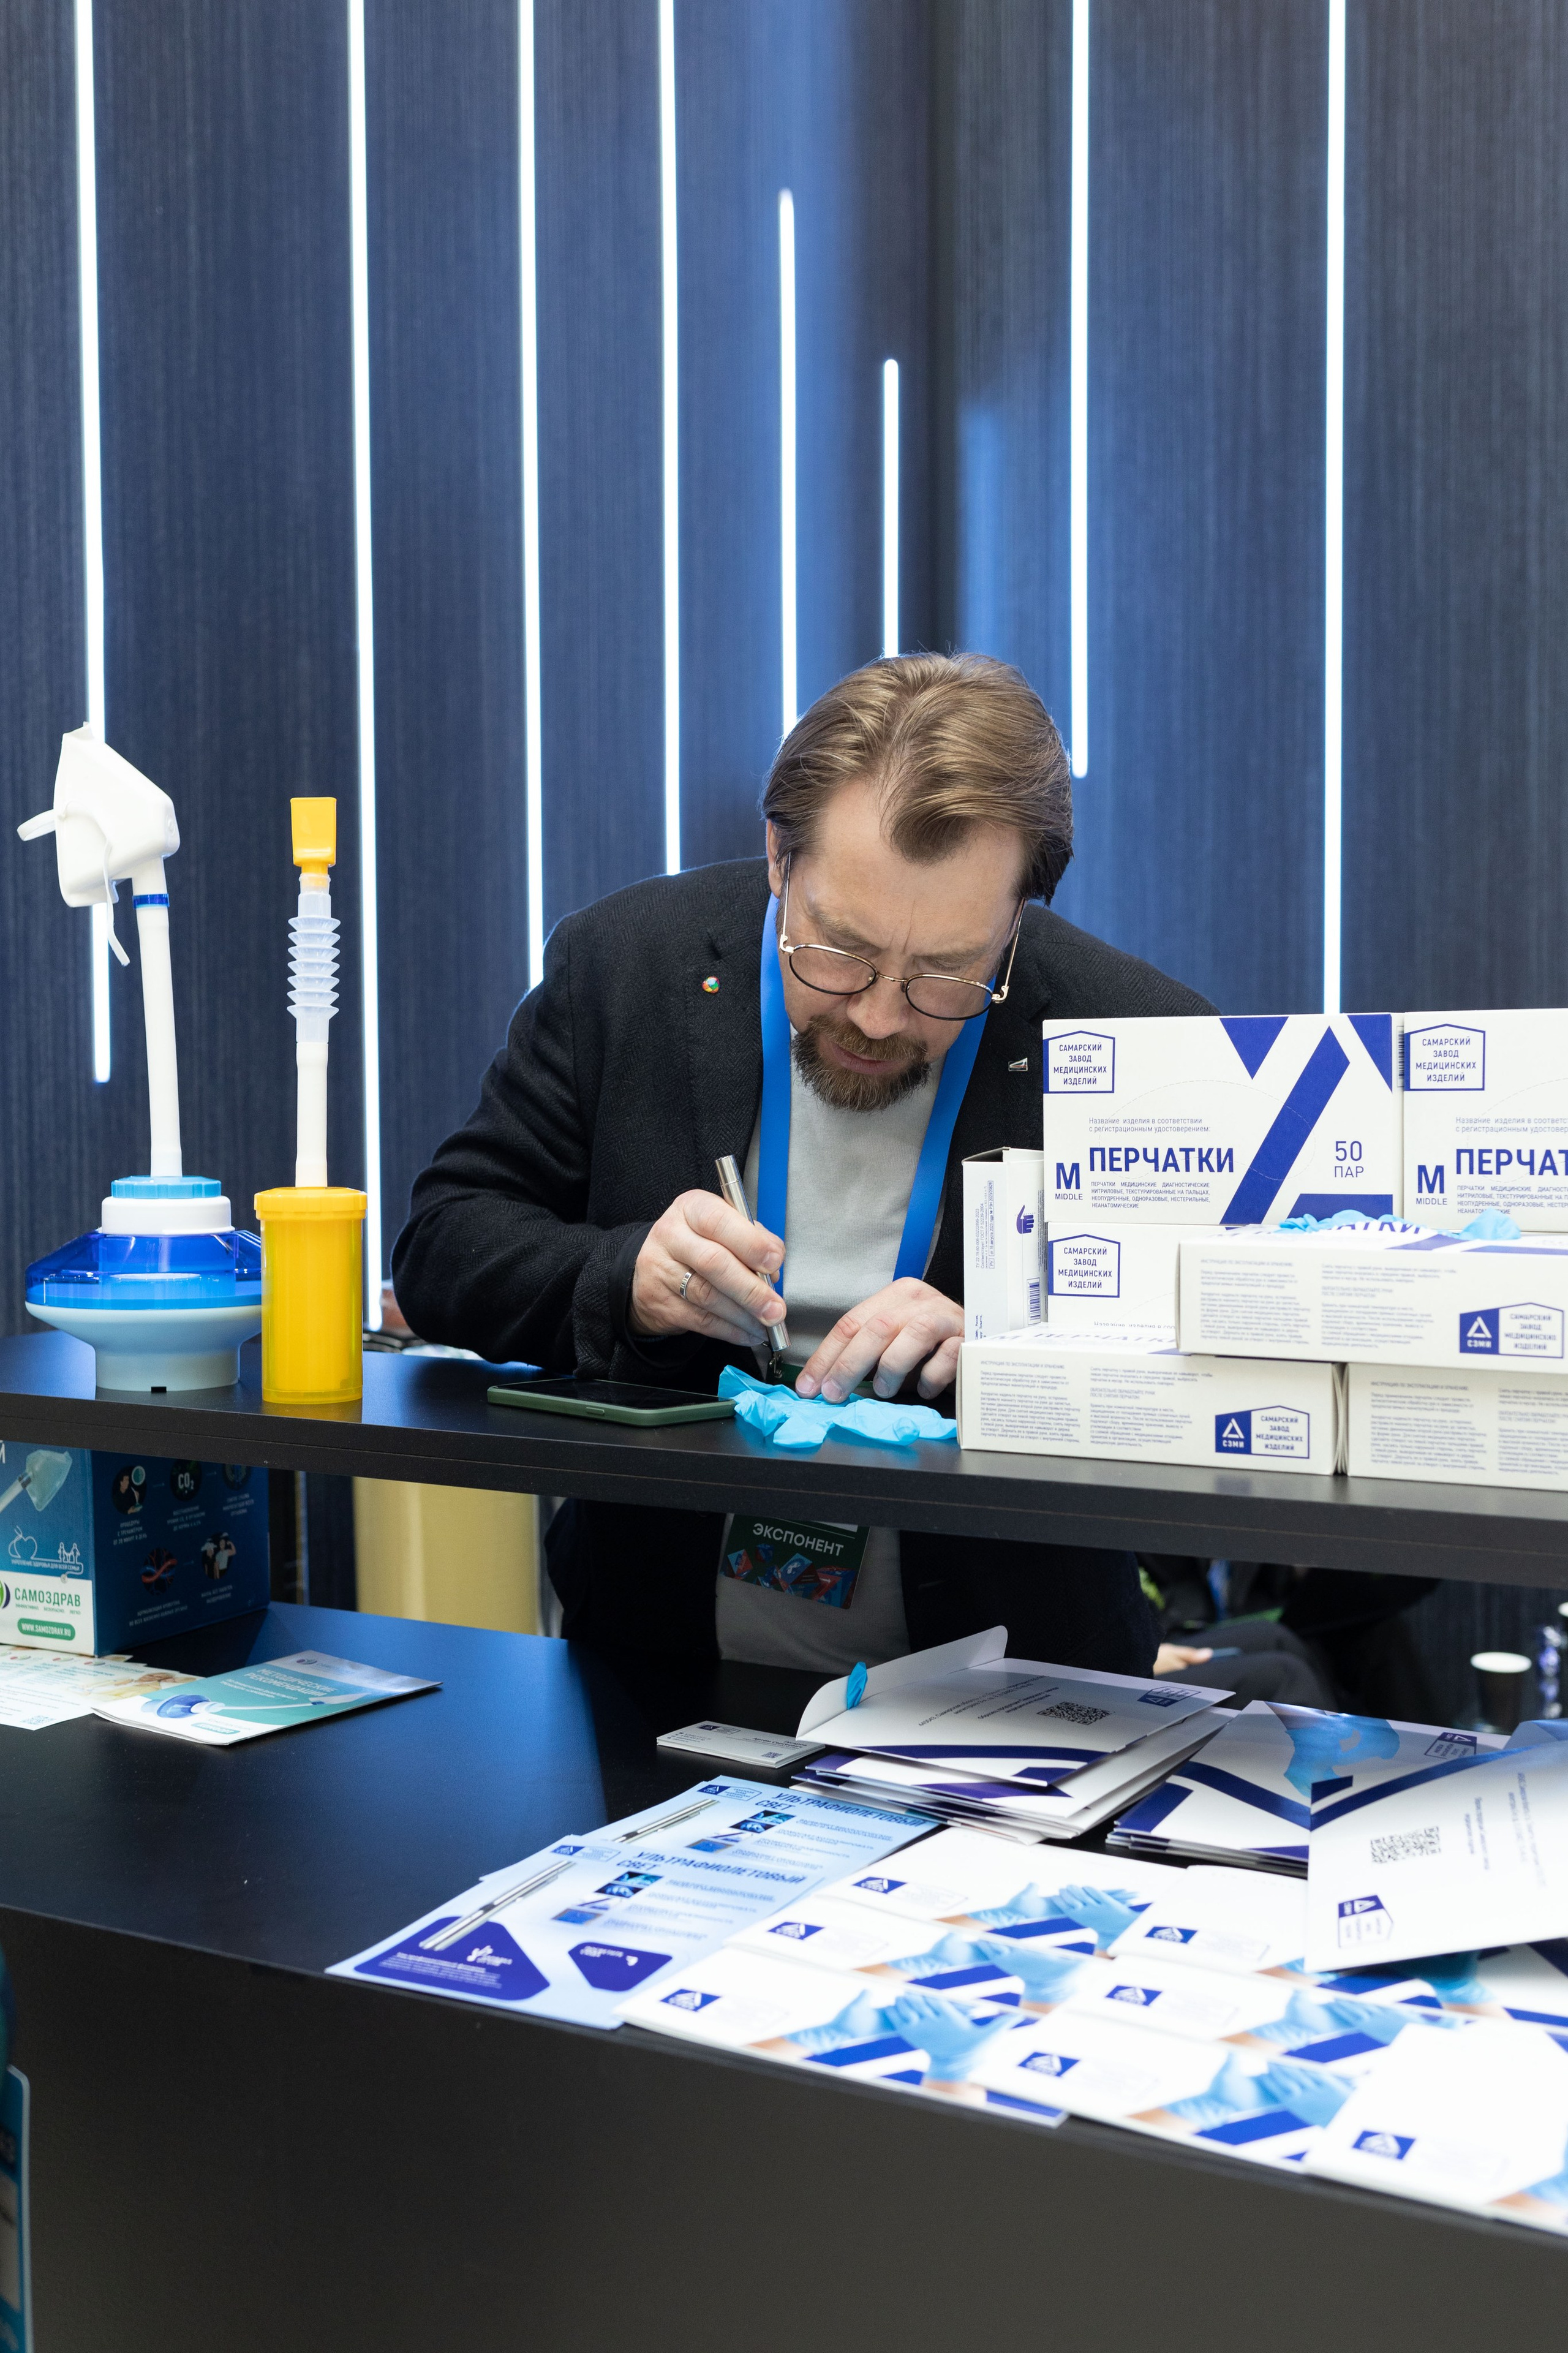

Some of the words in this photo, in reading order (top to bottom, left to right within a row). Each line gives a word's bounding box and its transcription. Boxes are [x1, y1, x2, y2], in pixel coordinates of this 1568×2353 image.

[1422, 1037, 1471, 1046] САМАРСКИЙ
[1063, 1076, 1096, 1085] ИЗДЕЛИЙ
[1427, 1073, 1464, 1082] ИЗДЕЛИЙ
[1089, 1147, 1234, 1172] ПЕРЧАТКИ
[1335, 1141, 1362, 1161] 50
[1056, 1163, 1080, 1189] M
[1334, 1166, 1363, 1177] ПАР
[1417, 1165, 1444, 1193] M
[753, 1523, 843, 1556] ЭКСПОНЕНТ
[15, 1587, 80, 1607] САМОЗДРАВ
[21, 1623, 71, 1637] WWW.SAMOZDRAV.RU
[257, 1668, 338, 1693] МЕТОДИЧЕСКИЕ
[754, 1799, 795, 1813] СВЕТ
[772, 1792, 928, 1827] УЛЬТРАФИОЛЕТОВЫЙ
[617, 1859, 660, 1873] СВЕТ
[633, 1851, 807, 1885] УЛЬТРАФИОЛЕТОВЫЙ
